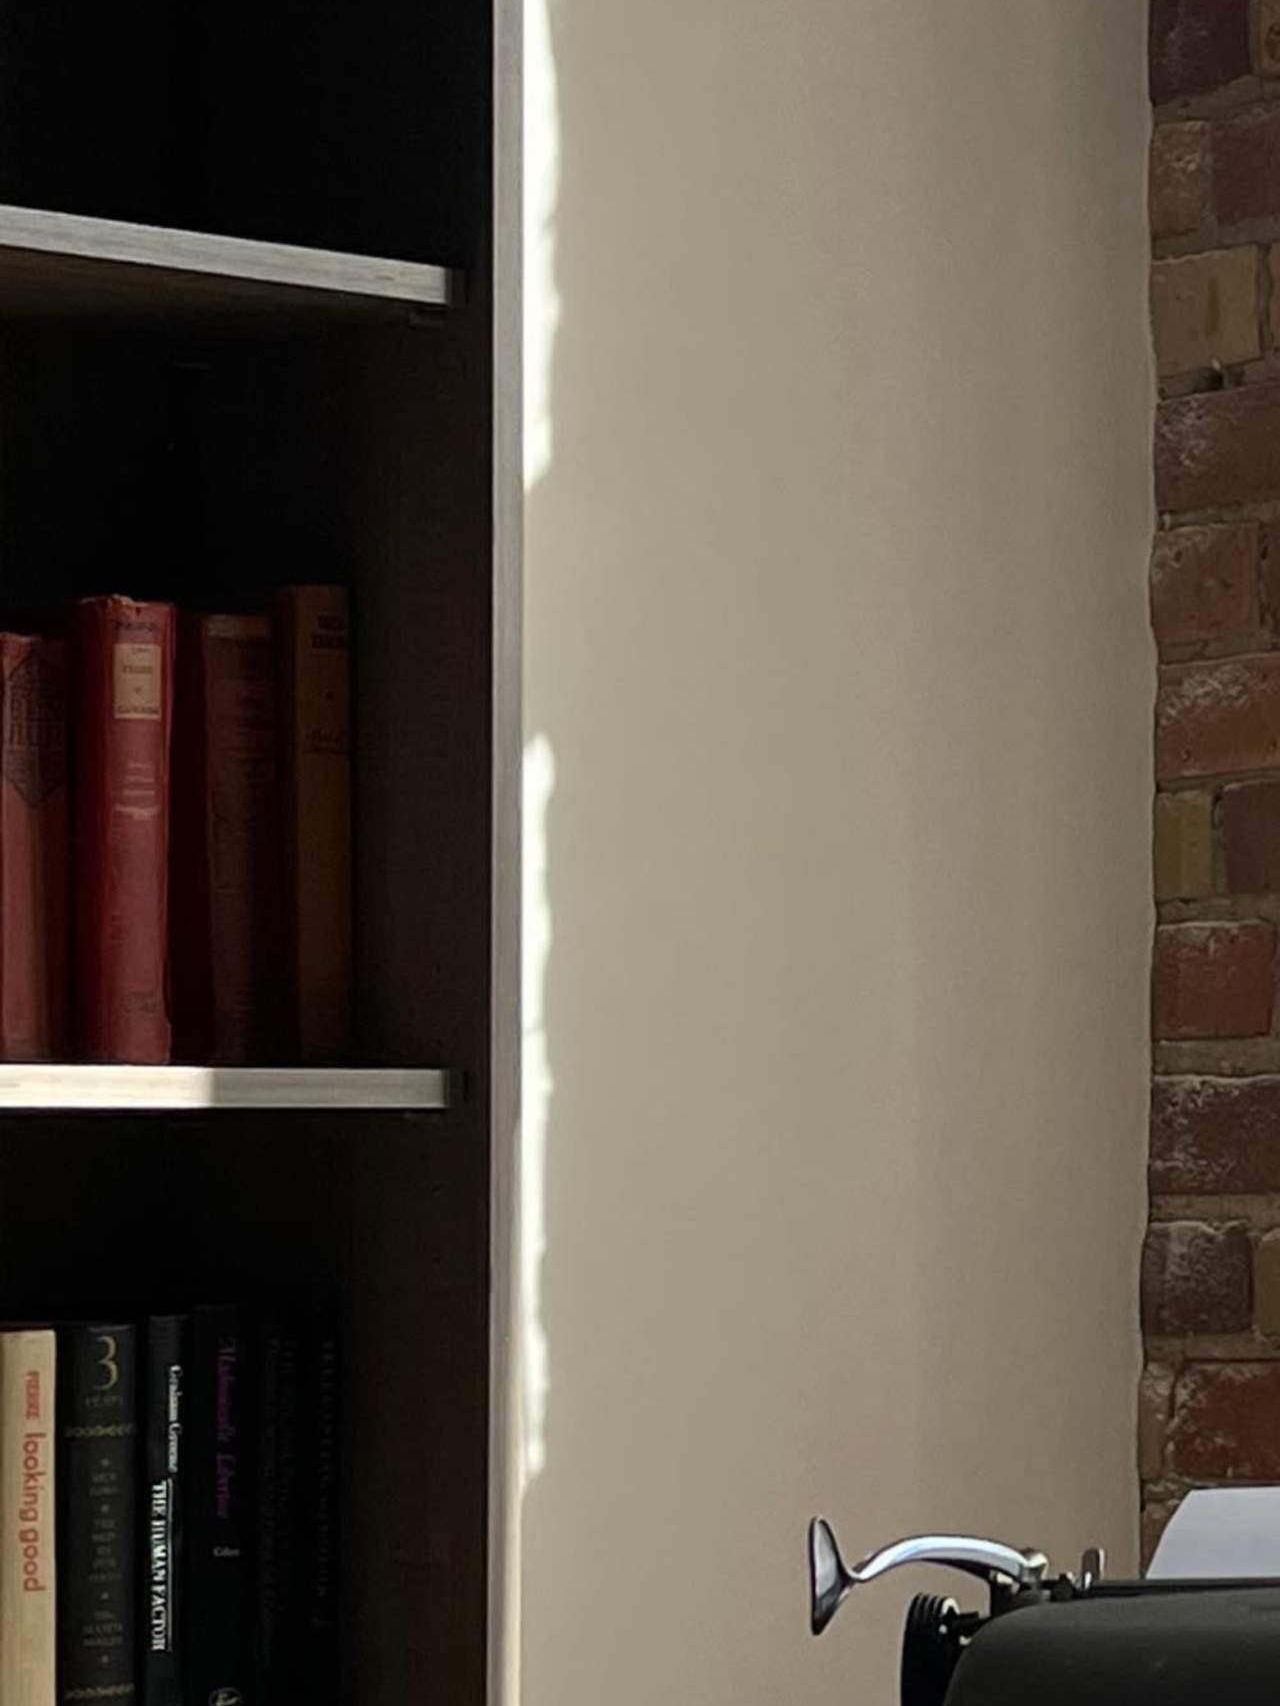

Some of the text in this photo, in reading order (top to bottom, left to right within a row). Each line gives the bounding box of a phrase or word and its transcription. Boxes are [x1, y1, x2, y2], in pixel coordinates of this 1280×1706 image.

[95, 1335, 119, 1391] 3
[19, 1432, 47, 1592] looking good
[151, 1480, 167, 1651] THE HUMAN FACTOR
